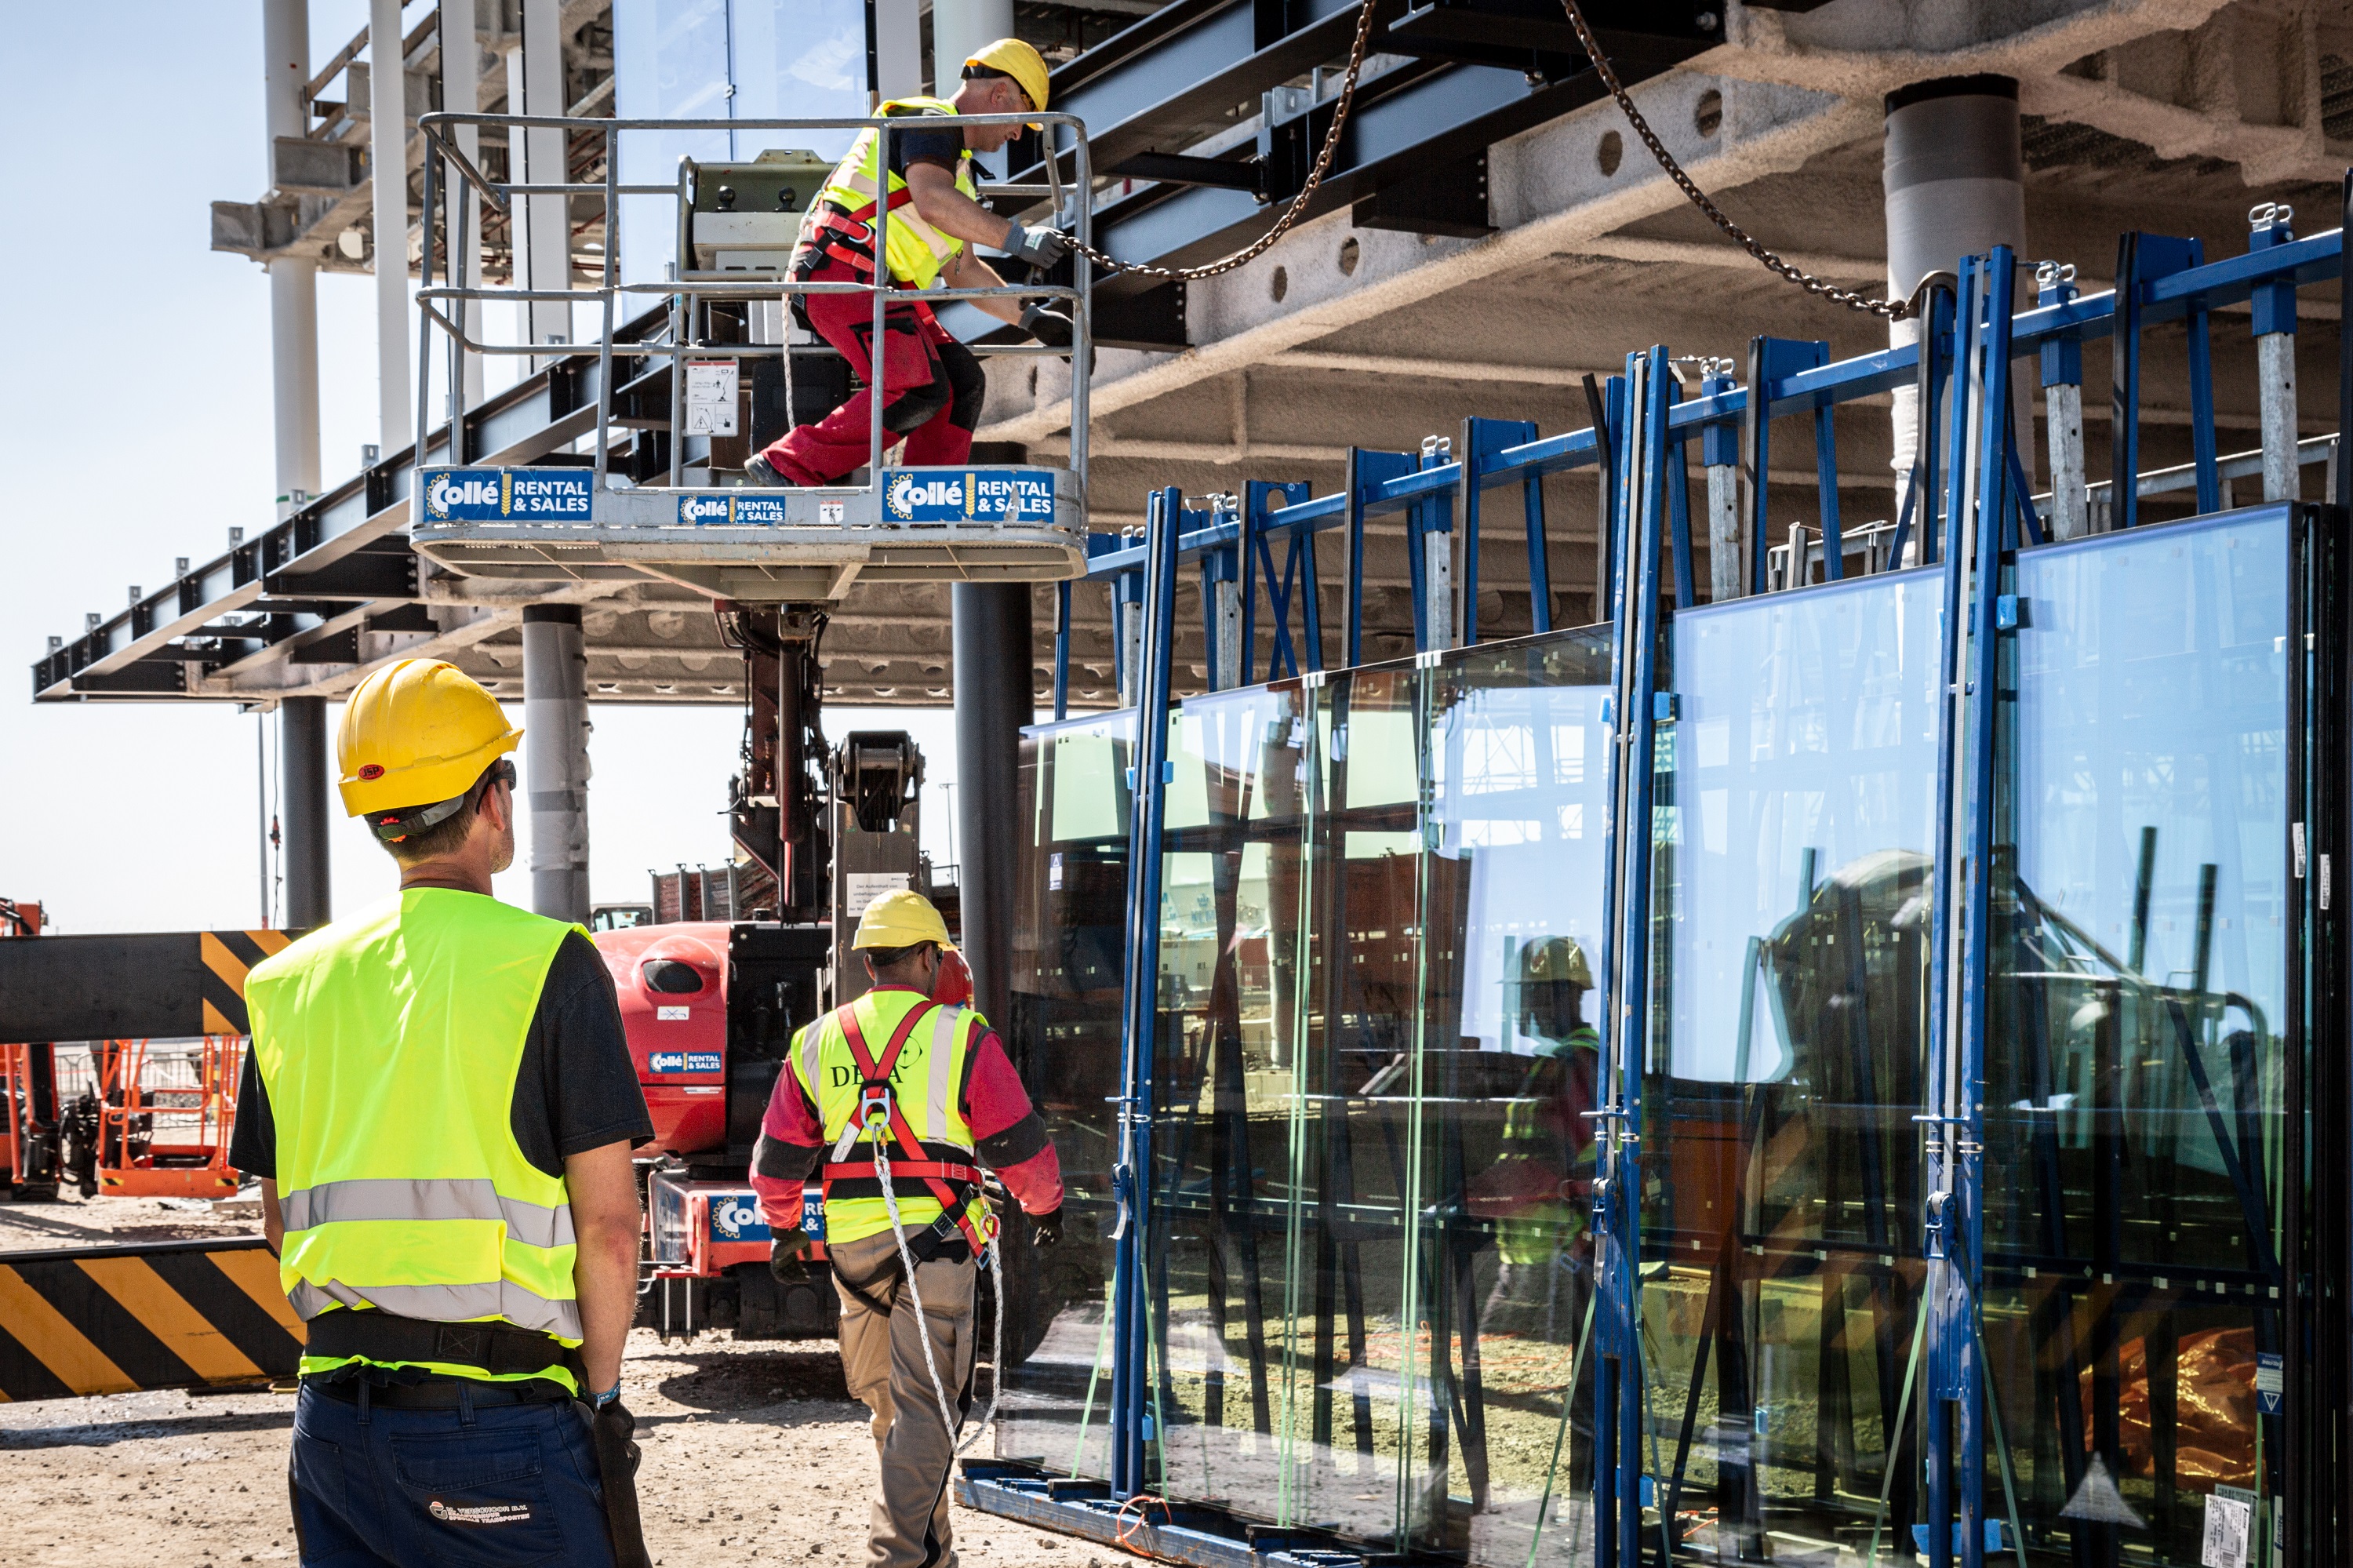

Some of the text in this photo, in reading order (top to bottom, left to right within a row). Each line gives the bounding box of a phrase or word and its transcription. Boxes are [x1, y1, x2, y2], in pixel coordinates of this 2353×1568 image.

[431, 479, 588, 512] Collé RENTAL
[893, 479, 1051, 514] Collé RENTAL
[514, 498, 588, 511] & SALES
[684, 499, 784, 521] Collé RENTAL
[977, 498, 1051, 514] & SALES
[736, 511, 784, 521] & SALES
[363, 766, 380, 777] JSP
[652, 1054, 682, 1070] Collé
[718, 1201, 769, 1233] Col
[805, 1217, 819, 1231] &
